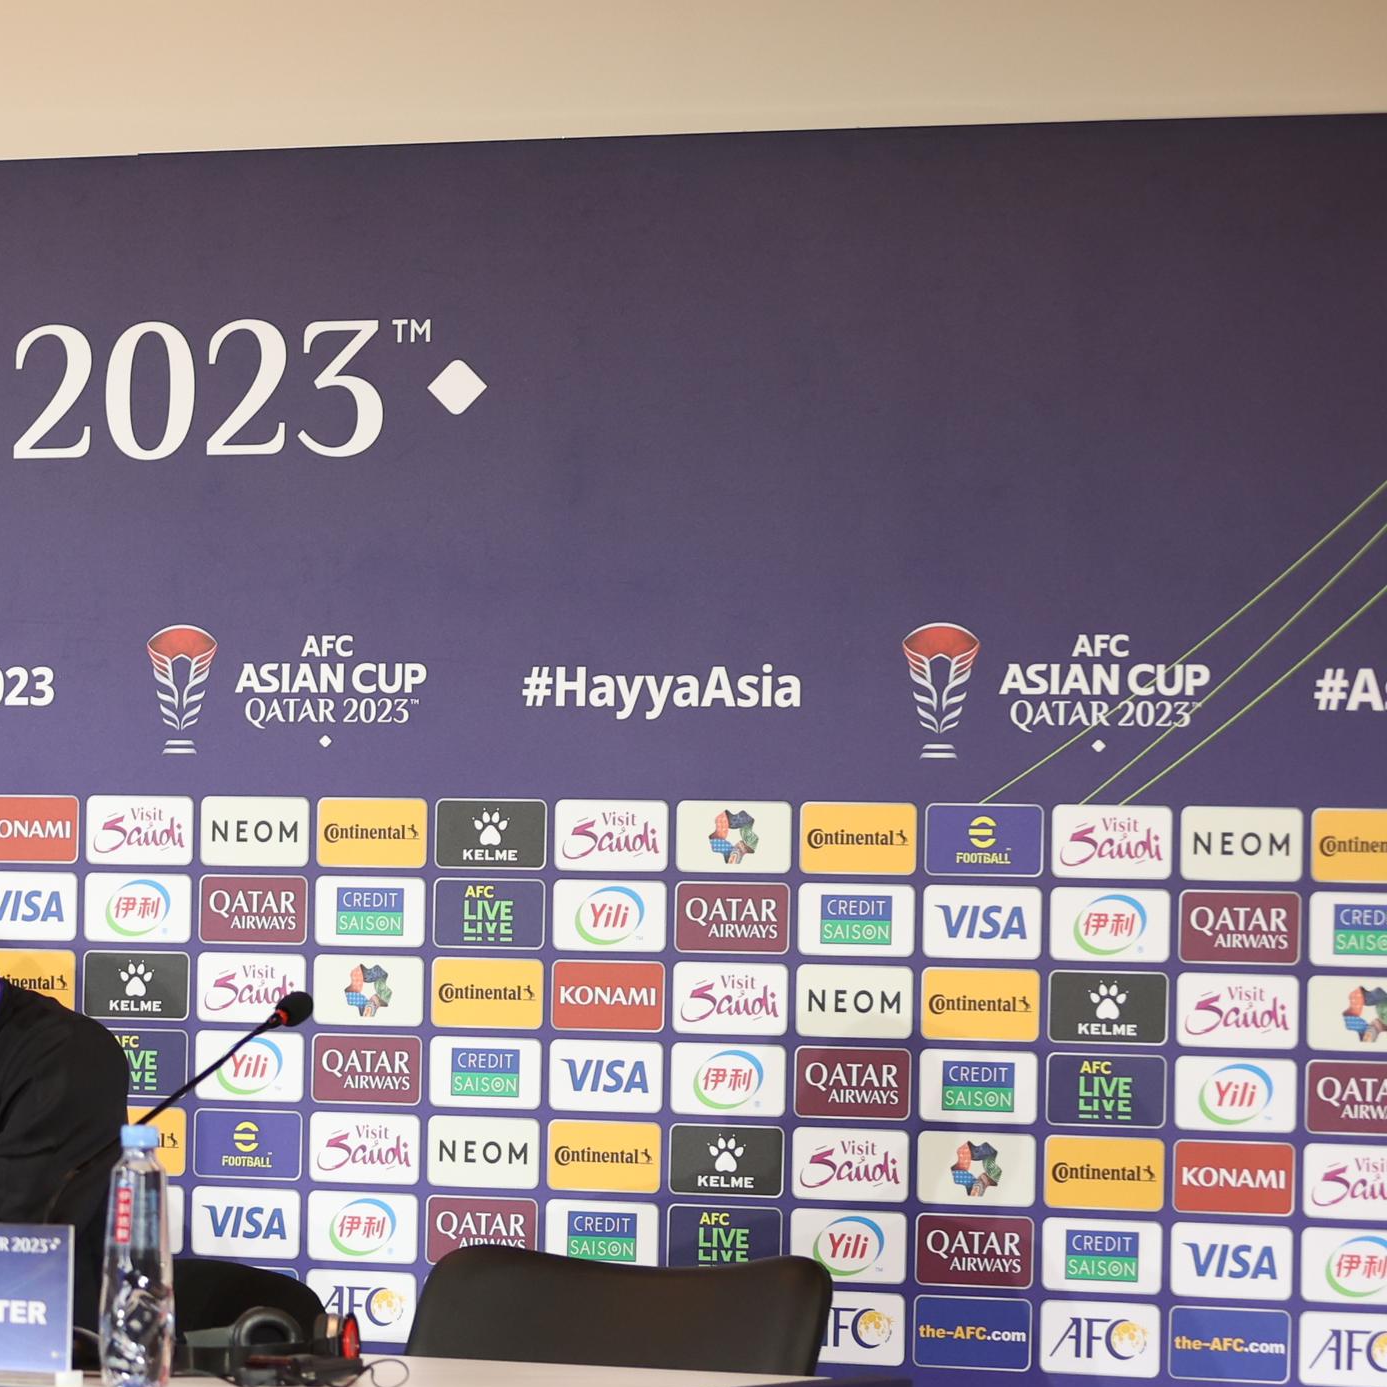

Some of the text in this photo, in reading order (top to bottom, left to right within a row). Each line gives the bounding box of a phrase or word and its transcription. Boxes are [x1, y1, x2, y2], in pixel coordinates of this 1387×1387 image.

[301, 635, 353, 657] AFC
[1072, 634, 1129, 657] AFC
[235, 663, 426, 693] ASIAN CUP
[999, 663, 1211, 696] ASIAN CUP
[522, 664, 800, 719] #HayyaAsia
[245, 698, 335, 729] QATAR
[1010, 699, 1111, 733] QATAR
[602, 812, 635, 826] Visit
[463, 849, 517, 860] KELME
[956, 853, 1011, 864] FOOTBALL
[210, 890, 295, 920] QATAR
[231, 916, 295, 929] AIRWAYS
[439, 983, 521, 1003] Continental
[1078, 1023, 1137, 1036] KELME
[222, 1156, 272, 1167] FOOTBALL
[927, 1230, 1021, 1259] QATAR
[1072, 1233, 1132, 1253] CREDIT
[950, 1257, 1021, 1273] AIRWAYS
[1183, 1243, 1277, 1280] VISA
[919, 1325, 1026, 1342] the-AFC.com
[1175, 1336, 1285, 1354] the-AFC.com
